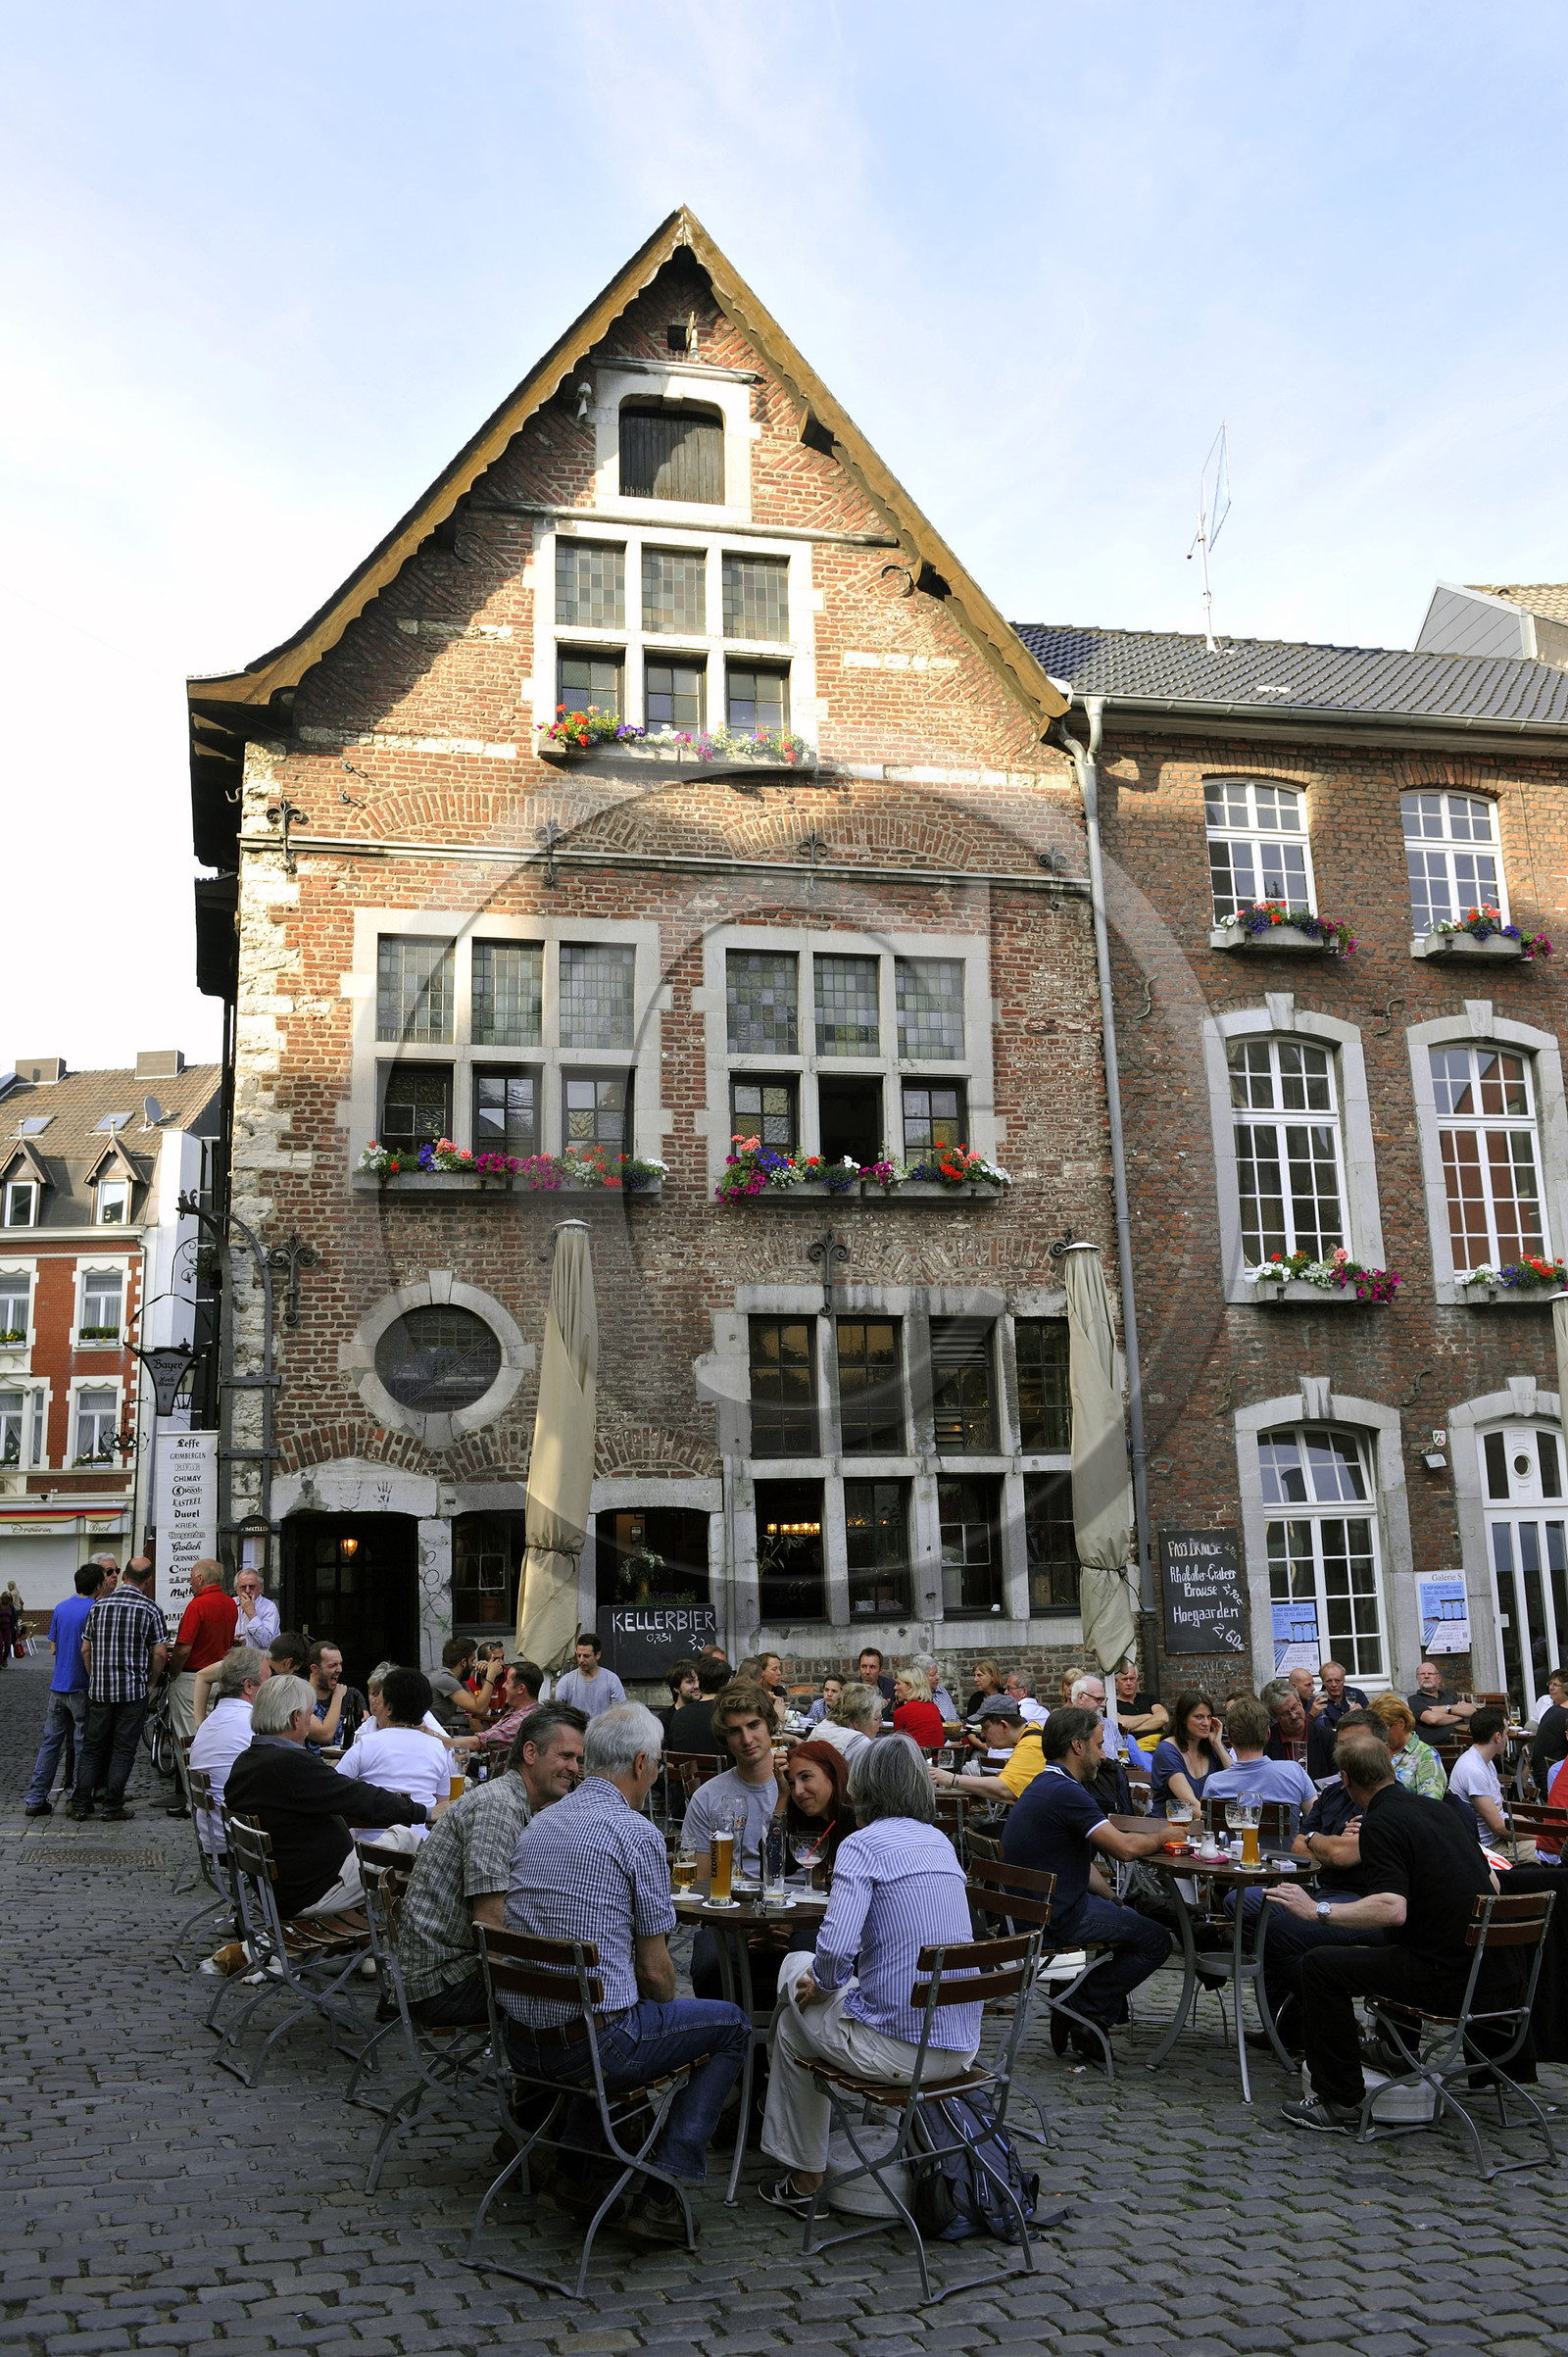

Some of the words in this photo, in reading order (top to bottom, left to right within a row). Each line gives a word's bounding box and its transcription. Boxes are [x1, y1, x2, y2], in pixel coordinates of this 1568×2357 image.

[152, 1358, 183, 1371] Bayer
[176, 1438, 200, 1449] Leffe
[170, 1451, 206, 1460] GRIMBERGEN
[172, 1498, 202, 1507] KASTEEL
[174, 1509, 200, 1518] Duvel
[168, 1531, 206, 1540] Hoegaarden
[172, 1541, 201, 1553] Grolsch
[169, 1564, 192, 1574] Coro
[170, 1587, 193, 1598] Myth
[1184, 1582, 1218, 1597] Brause
[1173, 1600, 1240, 1628] Hoegaarden
[612, 1610, 715, 1633] KELLERBIER
